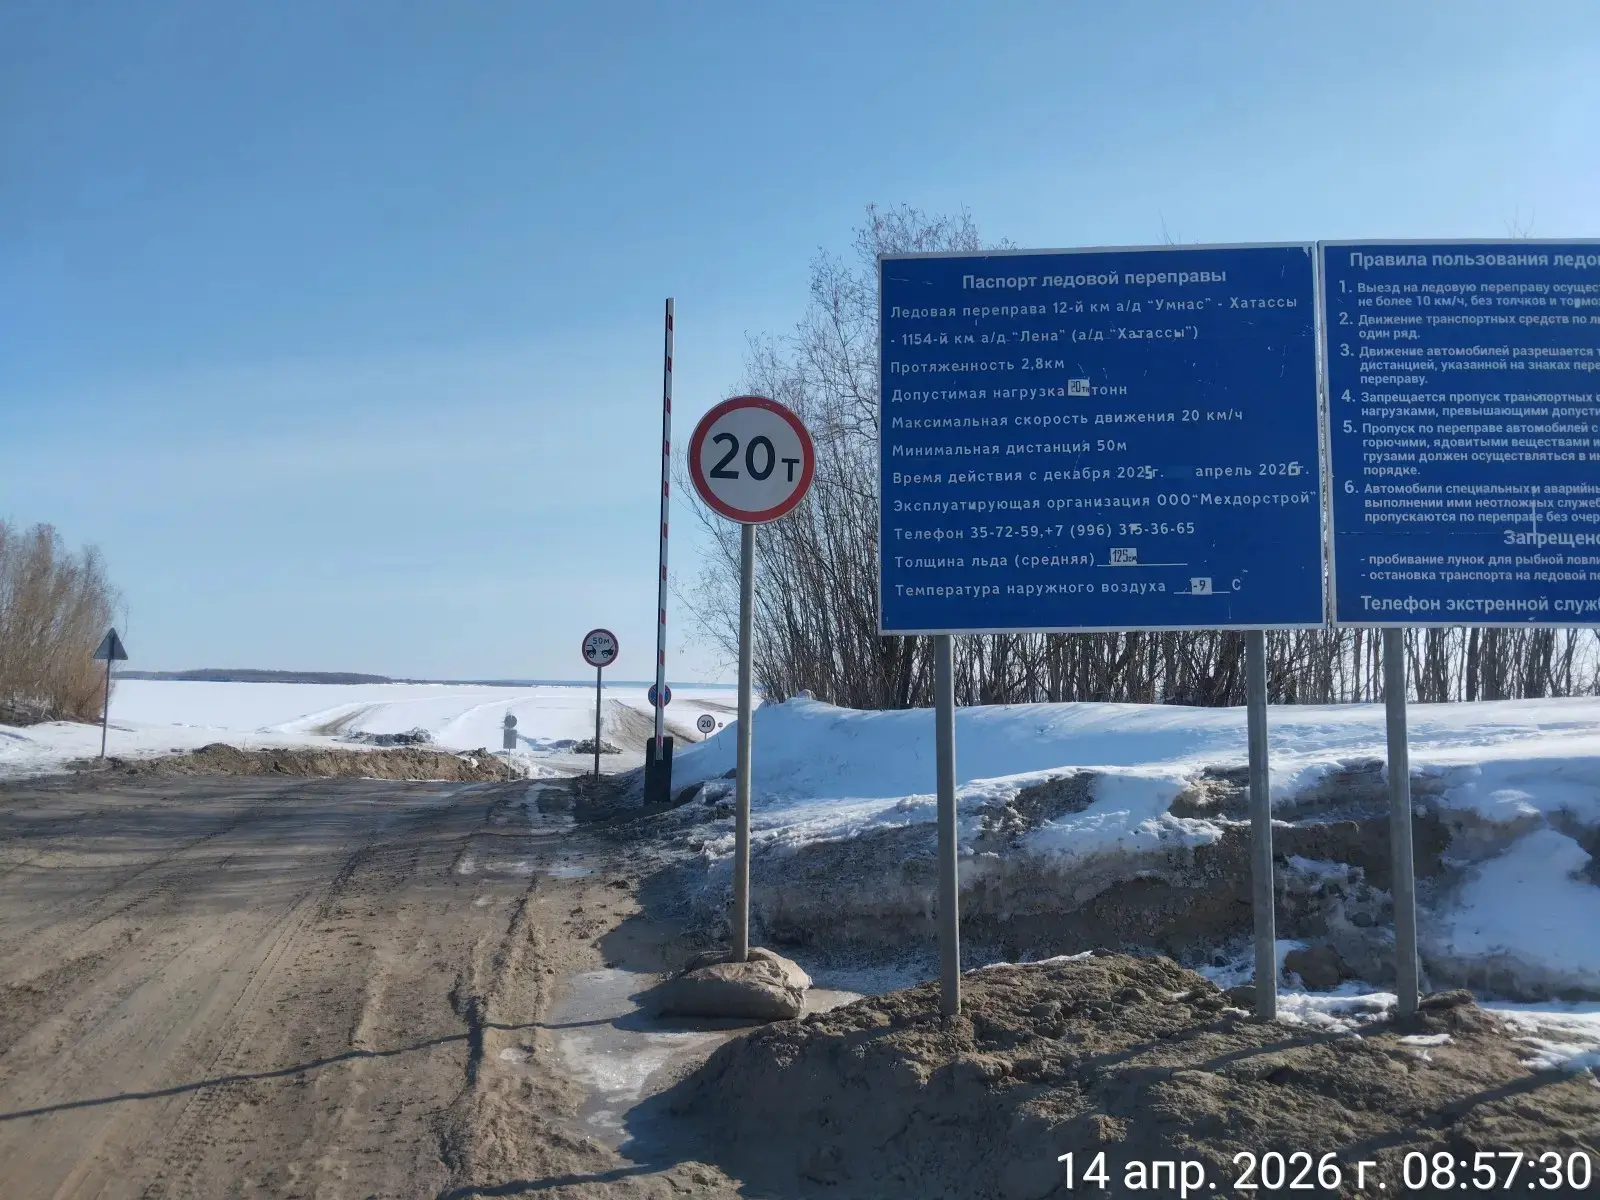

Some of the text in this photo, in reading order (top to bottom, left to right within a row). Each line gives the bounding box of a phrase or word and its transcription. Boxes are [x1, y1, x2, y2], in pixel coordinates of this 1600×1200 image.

[1350, 252, 1600, 271] Правила пользования ледо
[962, 270, 1227, 291] Паспорт ледовой переправы
[1338, 280, 1600, 295] 1. Выезд на ледовую переправу осущес
[890, 306, 956, 320] Ледовая
[962, 304, 1047, 319] переправа
[1052, 300, 1084, 314] 12-й
[1090, 304, 1110, 313] км
[1116, 300, 1142, 313] а/д
[1229, 296, 1297, 309] Хатассы
[1357, 294, 1600, 309] не более 10 км/ч, без толчков и тормо
[1338, 312, 1354, 325] 2.
[1357, 314, 1423, 327] Движение
[1425, 316, 1516, 327] транспортных
[1518, 316, 1570, 327] средств
[1571, 316, 1588, 325] по
[901, 332, 949, 346] 1154-й
[954, 334, 975, 344] км
[981, 332, 1006, 345] а/д
[1358, 330, 1421, 341] один ряд.
[1339, 342, 1355, 357] 3.
[1358, 346, 1424, 359] Движение
[1426, 344, 1510, 356] автомобилей
[1512, 348, 1594, 359] разрешается
[890, 358, 1065, 376] Протяженность 2,8км
[1359, 358, 1438, 373] дистанцией,
[1440, 358, 1508, 373] указанной
[1509, 362, 1525, 370] на
[1527, 362, 1571, 370] знаках
[1360, 376, 1428, 387] переправу.
[891, 390, 987, 403] Допустимая
[993, 388, 1065, 401] нагрузка
[1091, 386, 1127, 396] тонн
[1340, 390, 1356, 403] 4.
[1360, 392, 1446, 405] Запрещается
[1449, 394, 1501, 405] пропуск
[1503, 394, 1593, 405] транспортных
[891, 408, 1243, 429] Максимальная скорость движения 20 км/ч
[1361, 408, 1439, 419] нагрузками,
[1442, 408, 1549, 418] превышающими
[1343, 420, 1599, 436] 5. Пропуск по переправе автомобилей с
[892, 440, 1127, 457] Минимальная дистанция 50м
[1362, 440, 1430, 450] горючими,
[1433, 438, 1509, 450] ядовитыми
[1511, 438, 1590, 450] веществами
[710, 432, 800, 482] 20т
[1363, 452, 1416, 464] грузами
[1419, 452, 1470, 465] должен
[1470, 452, 1576, 465] осуществляться
[1578, 452, 1587, 461] в
[892, 472, 942, 487] Время
[947, 470, 1022, 485] действия
[1029, 472, 1037, 481] с
[1043, 466, 1111, 482] декабря
[1195, 466, 1252, 480] апрель
[1363, 466, 1421, 478] порядке.
[1344, 480, 1359, 494] 6.
[1364, 482, 1443, 494] Автомобили
[1445, 484, 1530, 496] специальных
[1530, 486, 1541, 496] и
[893, 500, 1040, 514] Эксплуатирующая
[1046, 498, 1150, 512] организация
[1364, 500, 1444, 508] выполнении
[1446, 500, 1472, 508] ими
[1475, 500, 1555, 511] неотложных
[1364, 514, 1457, 525] пропускаются
[1459, 514, 1475, 522] по
[1477, 512, 1544, 525] переправе
[1545, 510, 1569, 522] без
[893, 528, 964, 542] Телефон
[1070, 524, 1112, 540] (996)
[894, 556, 965, 569] Толщина
[971, 556, 1008, 568] льда
[1014, 552, 1095, 569] (средняя)
[1369, 554, 1444, 567] пробивание
[1446, 556, 1485, 567] лунок
[1487, 556, 1512, 567] для
[1515, 554, 1564, 568] рыбной
[1369, 572, 1437, 580] остановка
[1438, 572, 1513, 583] транспорта
[1515, 572, 1531, 581] на
[1533, 570, 1587, 583] ледовой
[894, 584, 1000, 599] Температура
[1006, 584, 1095, 597] наружного
[1101, 582, 1166, 595] воздуха
[1231, 578, 1242, 591] С
[1360, 596, 1600, 615] Телефон экстренной служ
